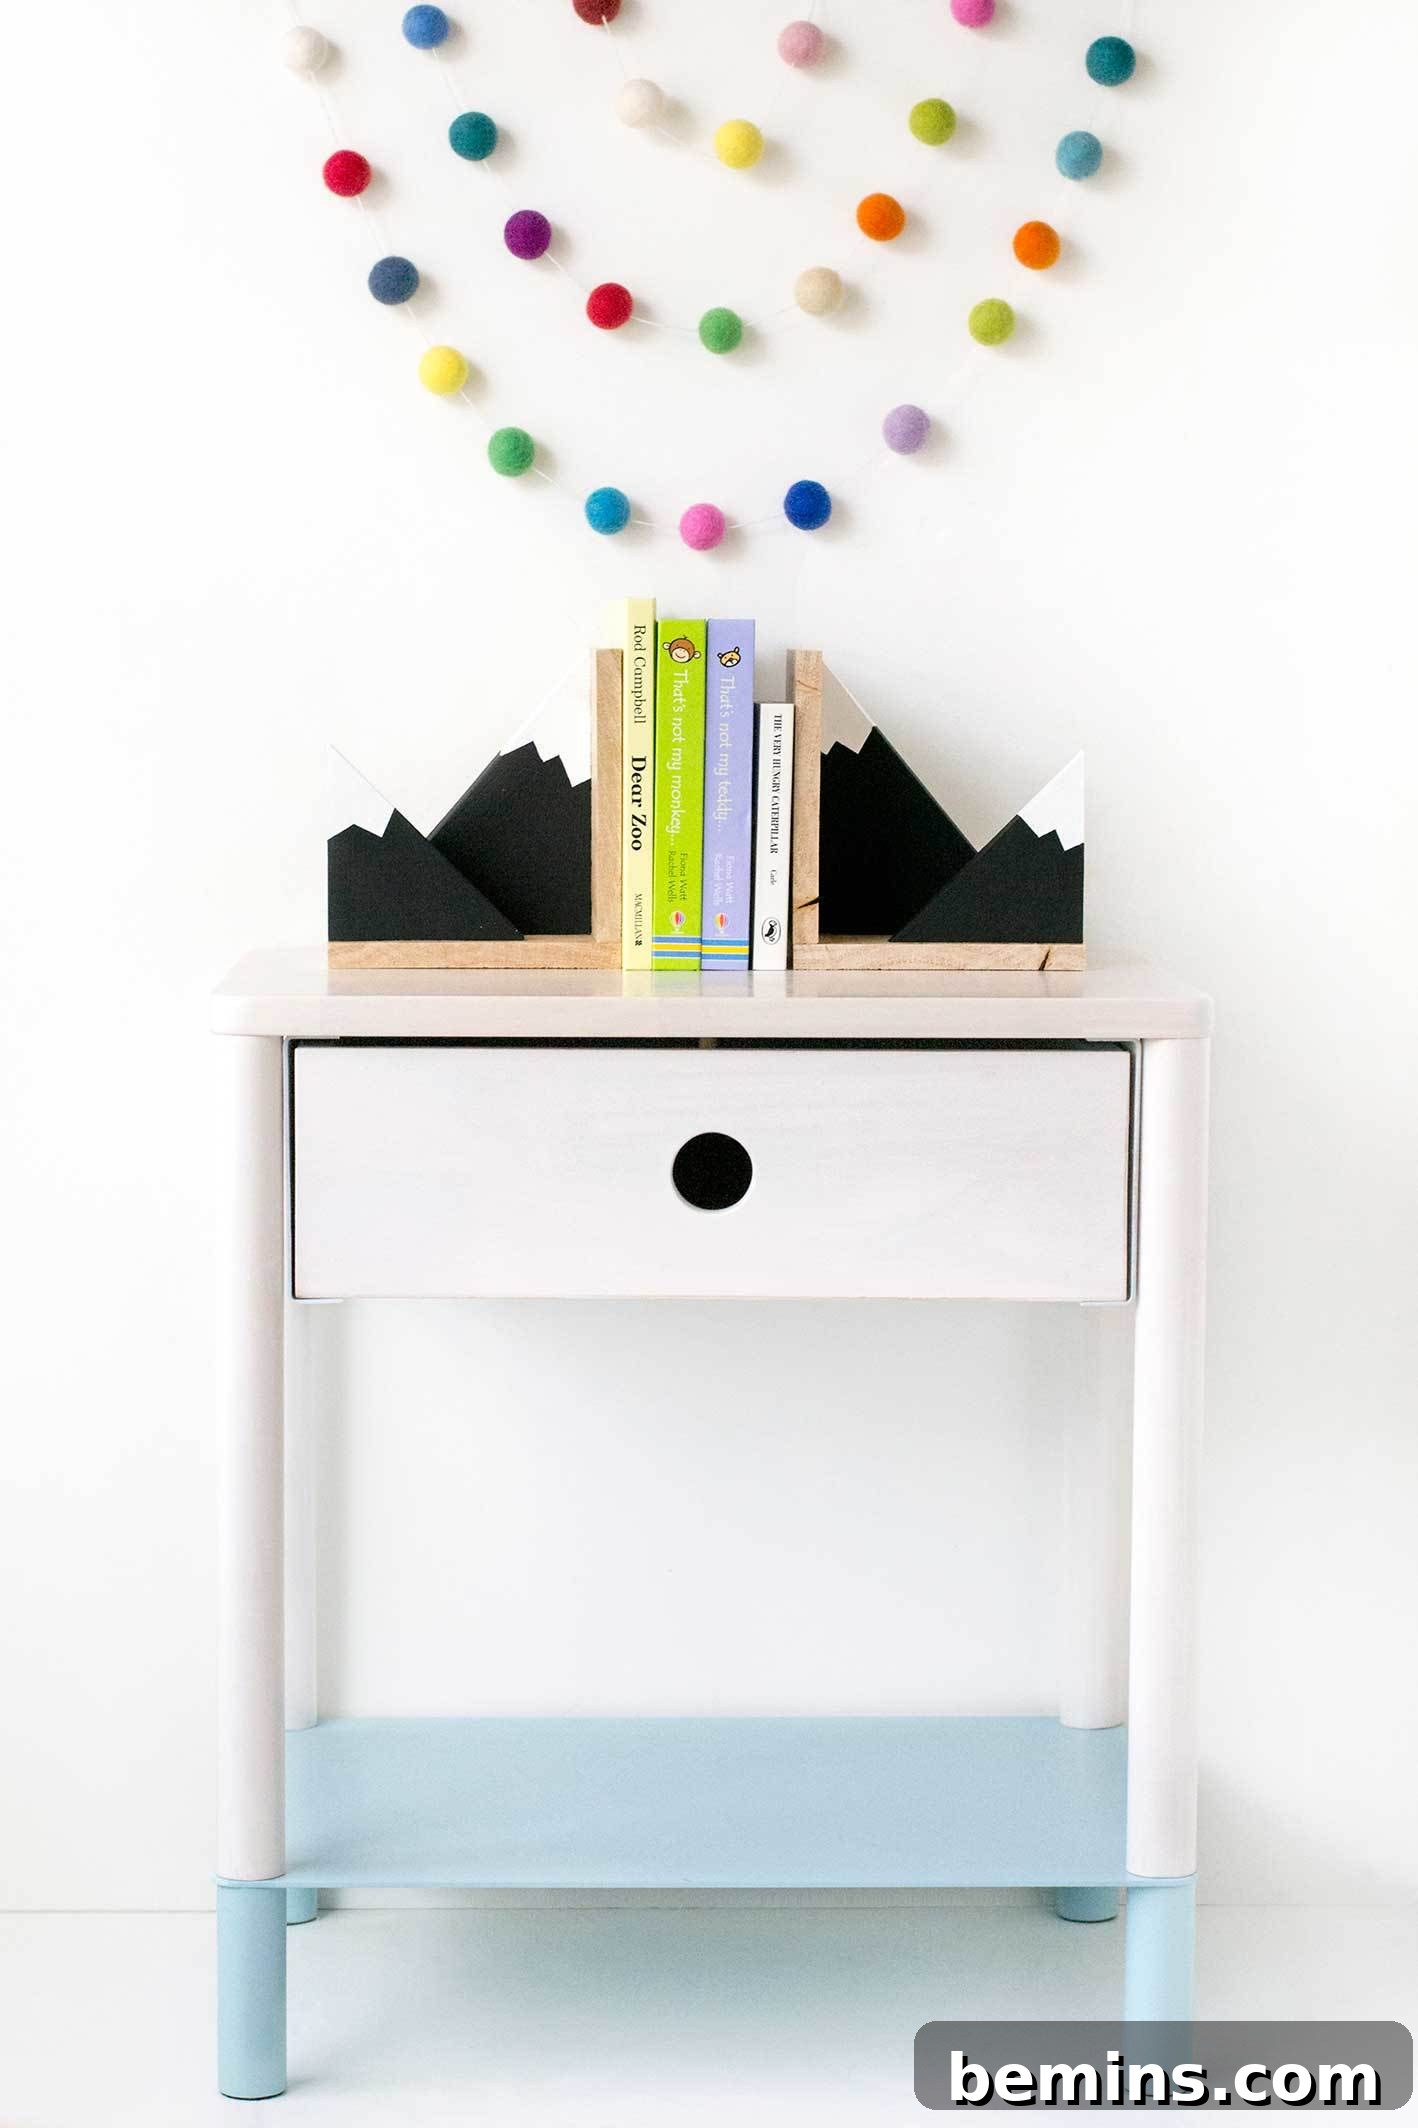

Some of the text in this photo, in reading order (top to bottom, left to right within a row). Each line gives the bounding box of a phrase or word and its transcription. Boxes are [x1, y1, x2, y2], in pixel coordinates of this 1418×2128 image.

[631, 625, 647, 724] Rod Campbell
[672, 669, 688, 713] That's
[720, 675, 736, 718] That's
[672, 717, 686, 743] not
[719, 723, 733, 748] not
[666, 748, 682, 770] my
[713, 753, 728, 776] my
[630, 755, 647, 851] Dear Zoo
[769, 714, 782, 854] THE VERY HUNGRY CATERPILLAR
[667, 850, 677, 904] Rachel Wells
[680, 852, 688, 901] Fiona Watt
[634, 893, 643, 940] MACMILLAN
